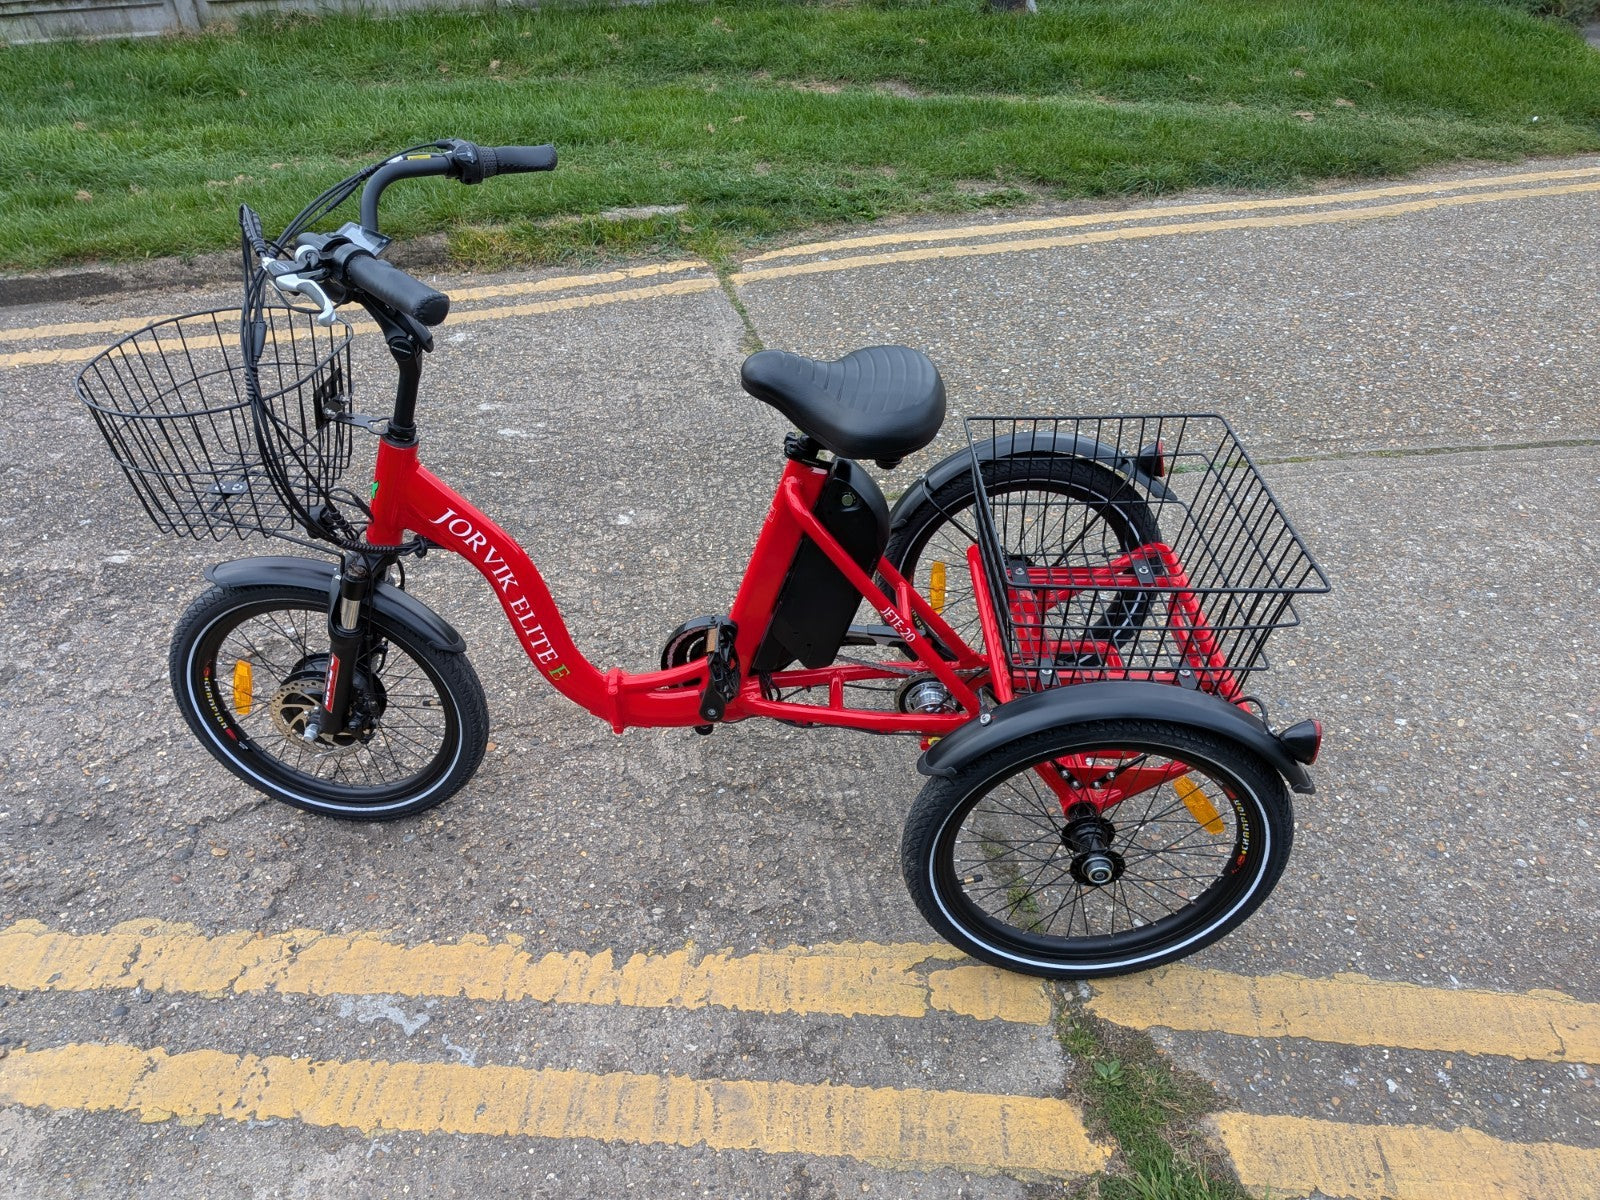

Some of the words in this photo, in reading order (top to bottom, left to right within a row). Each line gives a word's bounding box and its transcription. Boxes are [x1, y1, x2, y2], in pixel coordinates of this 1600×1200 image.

[428, 507, 519, 593] JORVIK
[509, 594, 559, 665] ELITE
[548, 663, 571, 681] E
[880, 606, 916, 642] JETE-20
